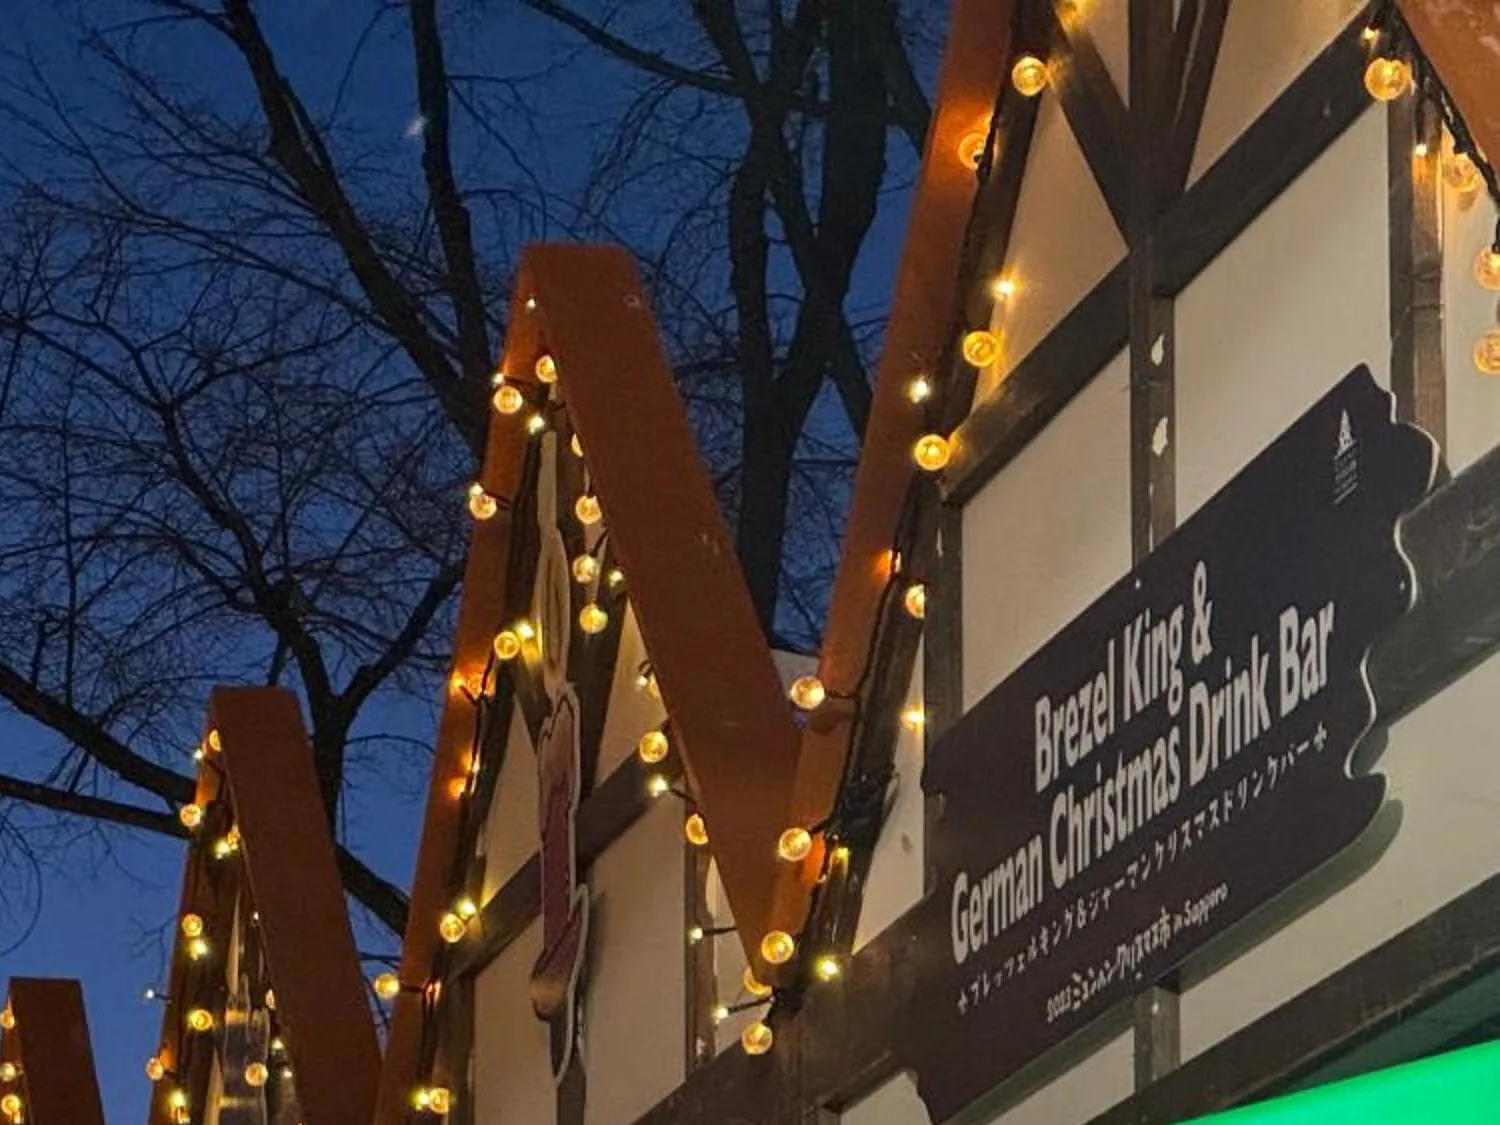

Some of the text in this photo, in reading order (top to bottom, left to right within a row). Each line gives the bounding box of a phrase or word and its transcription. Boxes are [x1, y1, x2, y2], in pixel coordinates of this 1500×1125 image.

[951, 601, 1335, 965] German Christmas Drink Bar
[1035, 560, 1213, 793] Brezel King &
[1184, 881, 1229, 927] Sapporo
